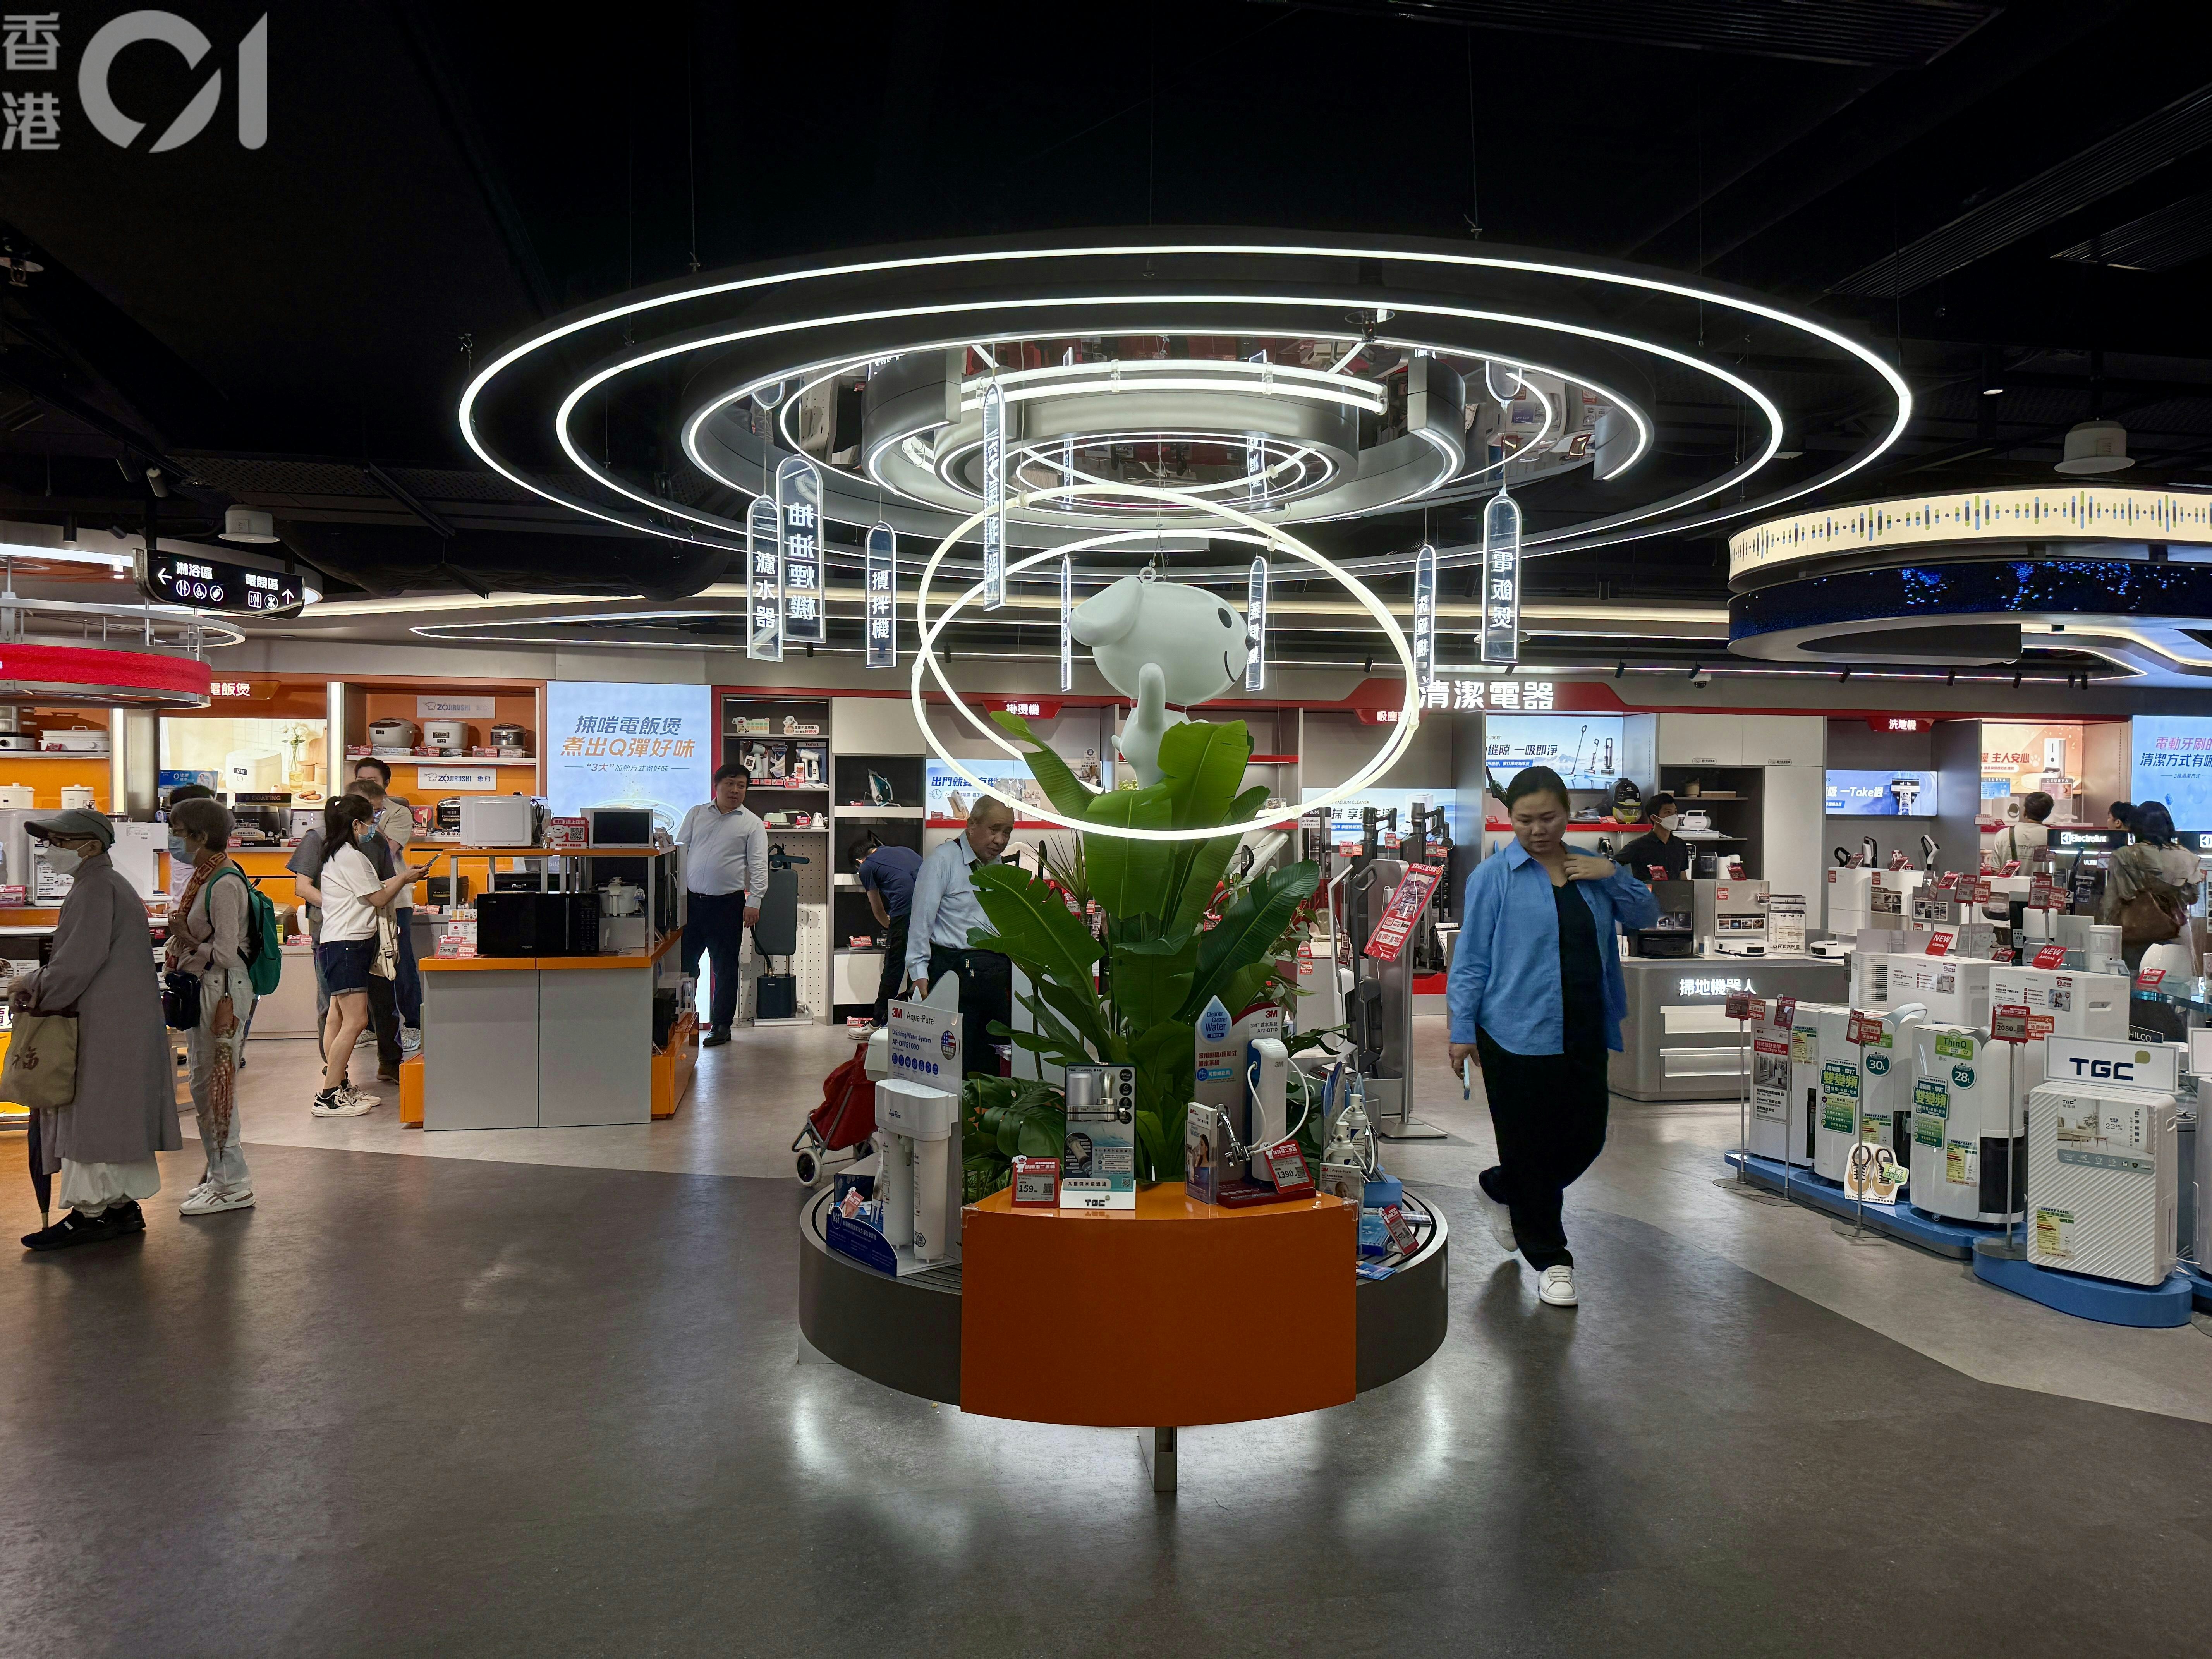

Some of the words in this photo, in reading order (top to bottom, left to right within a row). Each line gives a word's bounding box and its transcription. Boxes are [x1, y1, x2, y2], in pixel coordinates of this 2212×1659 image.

[176, 561, 213, 580] 淋浴區
[245, 574, 279, 591] 電競區
[756, 551, 776, 629] 濾水器
[872, 570, 890, 639] 攪拌機
[210, 682, 250, 697] 電飯煲
[1418, 680, 1554, 710] 清潔電器
[436, 704, 470, 712] ZOJIRUSHI
[1006, 703, 1040, 716] 掛燙機
[575, 715, 682, 735] 揀啱電飯煲
[1889, 719, 1917, 730] 洗地機
[560, 737, 696, 758] 煮出Q彈好味
[1514, 744, 1558, 756] 一吸即淨
[1991, 752, 2030, 763] 主人安心
[2071, 834, 2107, 843] Electrolux
[1933, 934, 1951, 943] NEW
[2041, 947, 2064, 955] NEW
[1679, 978, 1757, 996] 掃地機器人
[892, 1007, 902, 1019] 3M
[906, 1011, 934, 1025] Aqua-Pure
[1265, 1010, 1278, 1018] 3M
[1205, 1023, 1226, 1032] Water
[892, 1029, 907, 1039] Drinking
[918, 1035, 931, 1043] System
[1943, 1037, 1967, 1049] ThinQ
[2069, 1057, 2134, 1081] TGC
[1822, 1070, 1858, 1089] 雙變頻
[1277, 1170, 1294, 1179] 1390
[1018, 1185, 1034, 1193] 159
